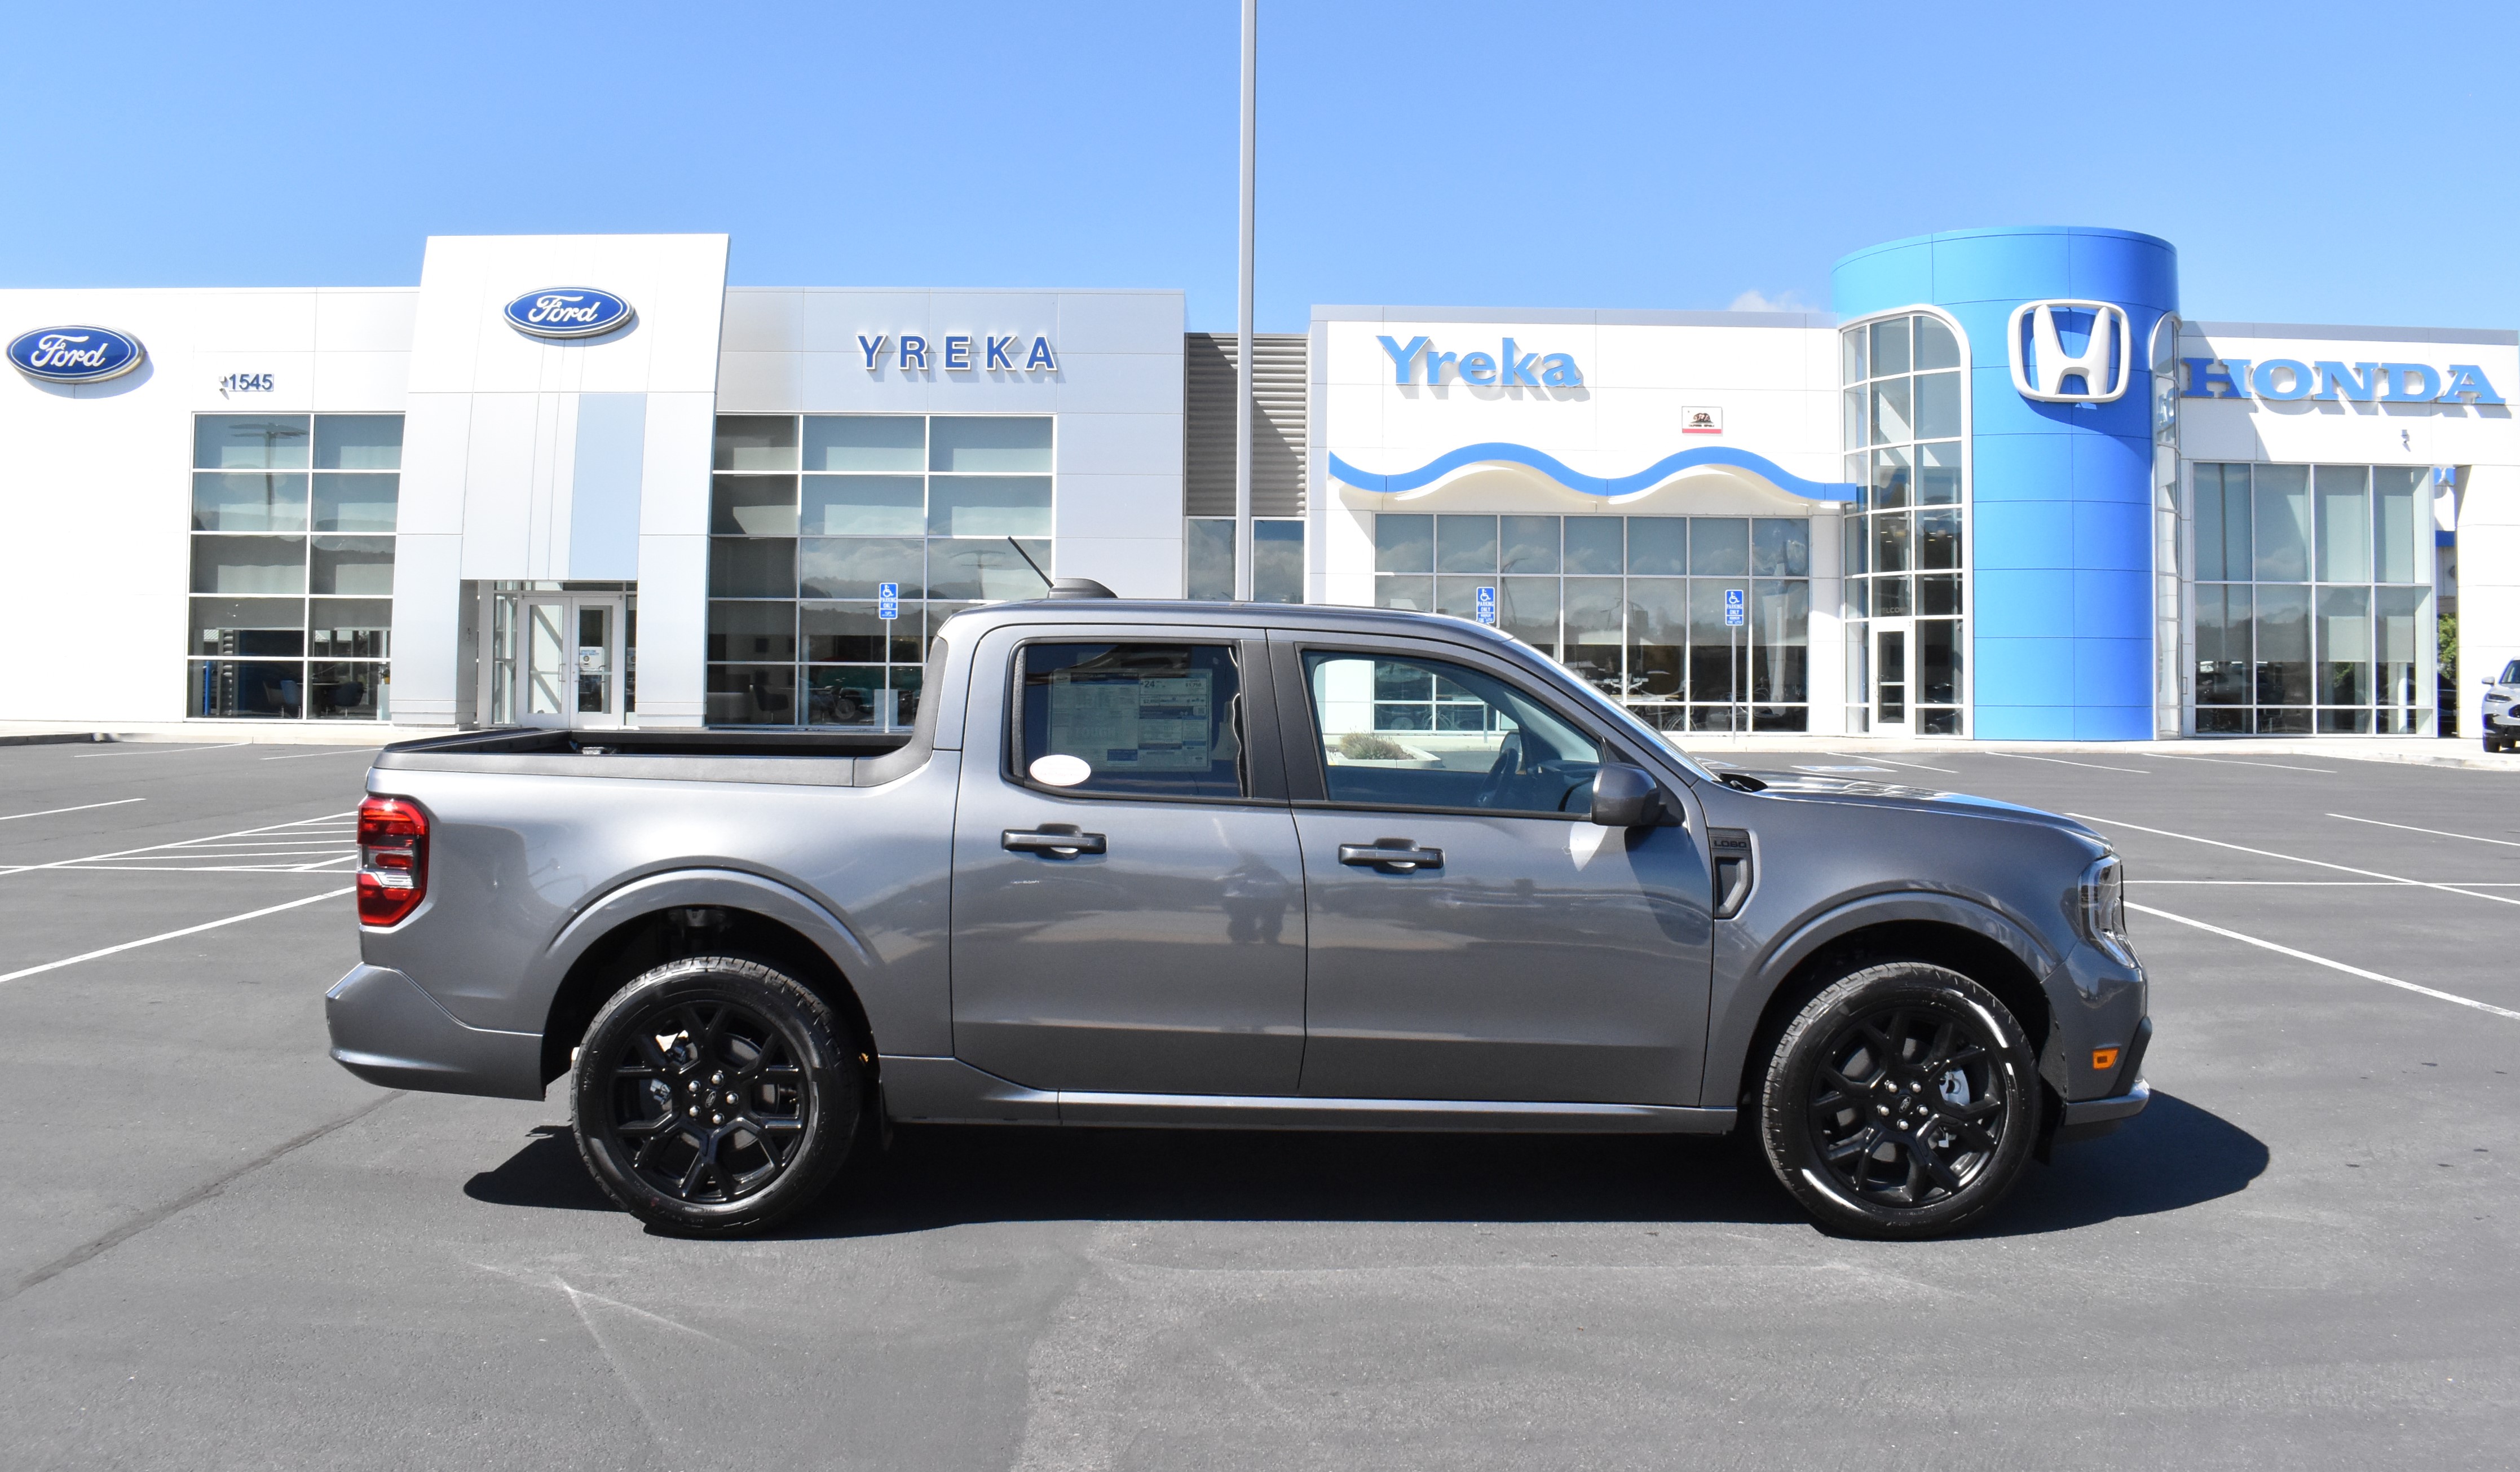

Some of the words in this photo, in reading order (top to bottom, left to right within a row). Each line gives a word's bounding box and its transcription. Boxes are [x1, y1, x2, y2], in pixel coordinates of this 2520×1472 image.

[528, 295, 601, 323] Ford
[30, 334, 108, 367] Ford
[855, 334, 1058, 371] YREKA
[1375, 335, 1582, 387] Yreka
[229, 373, 273, 390] 1545
[2182, 356, 2506, 404] HONDA
